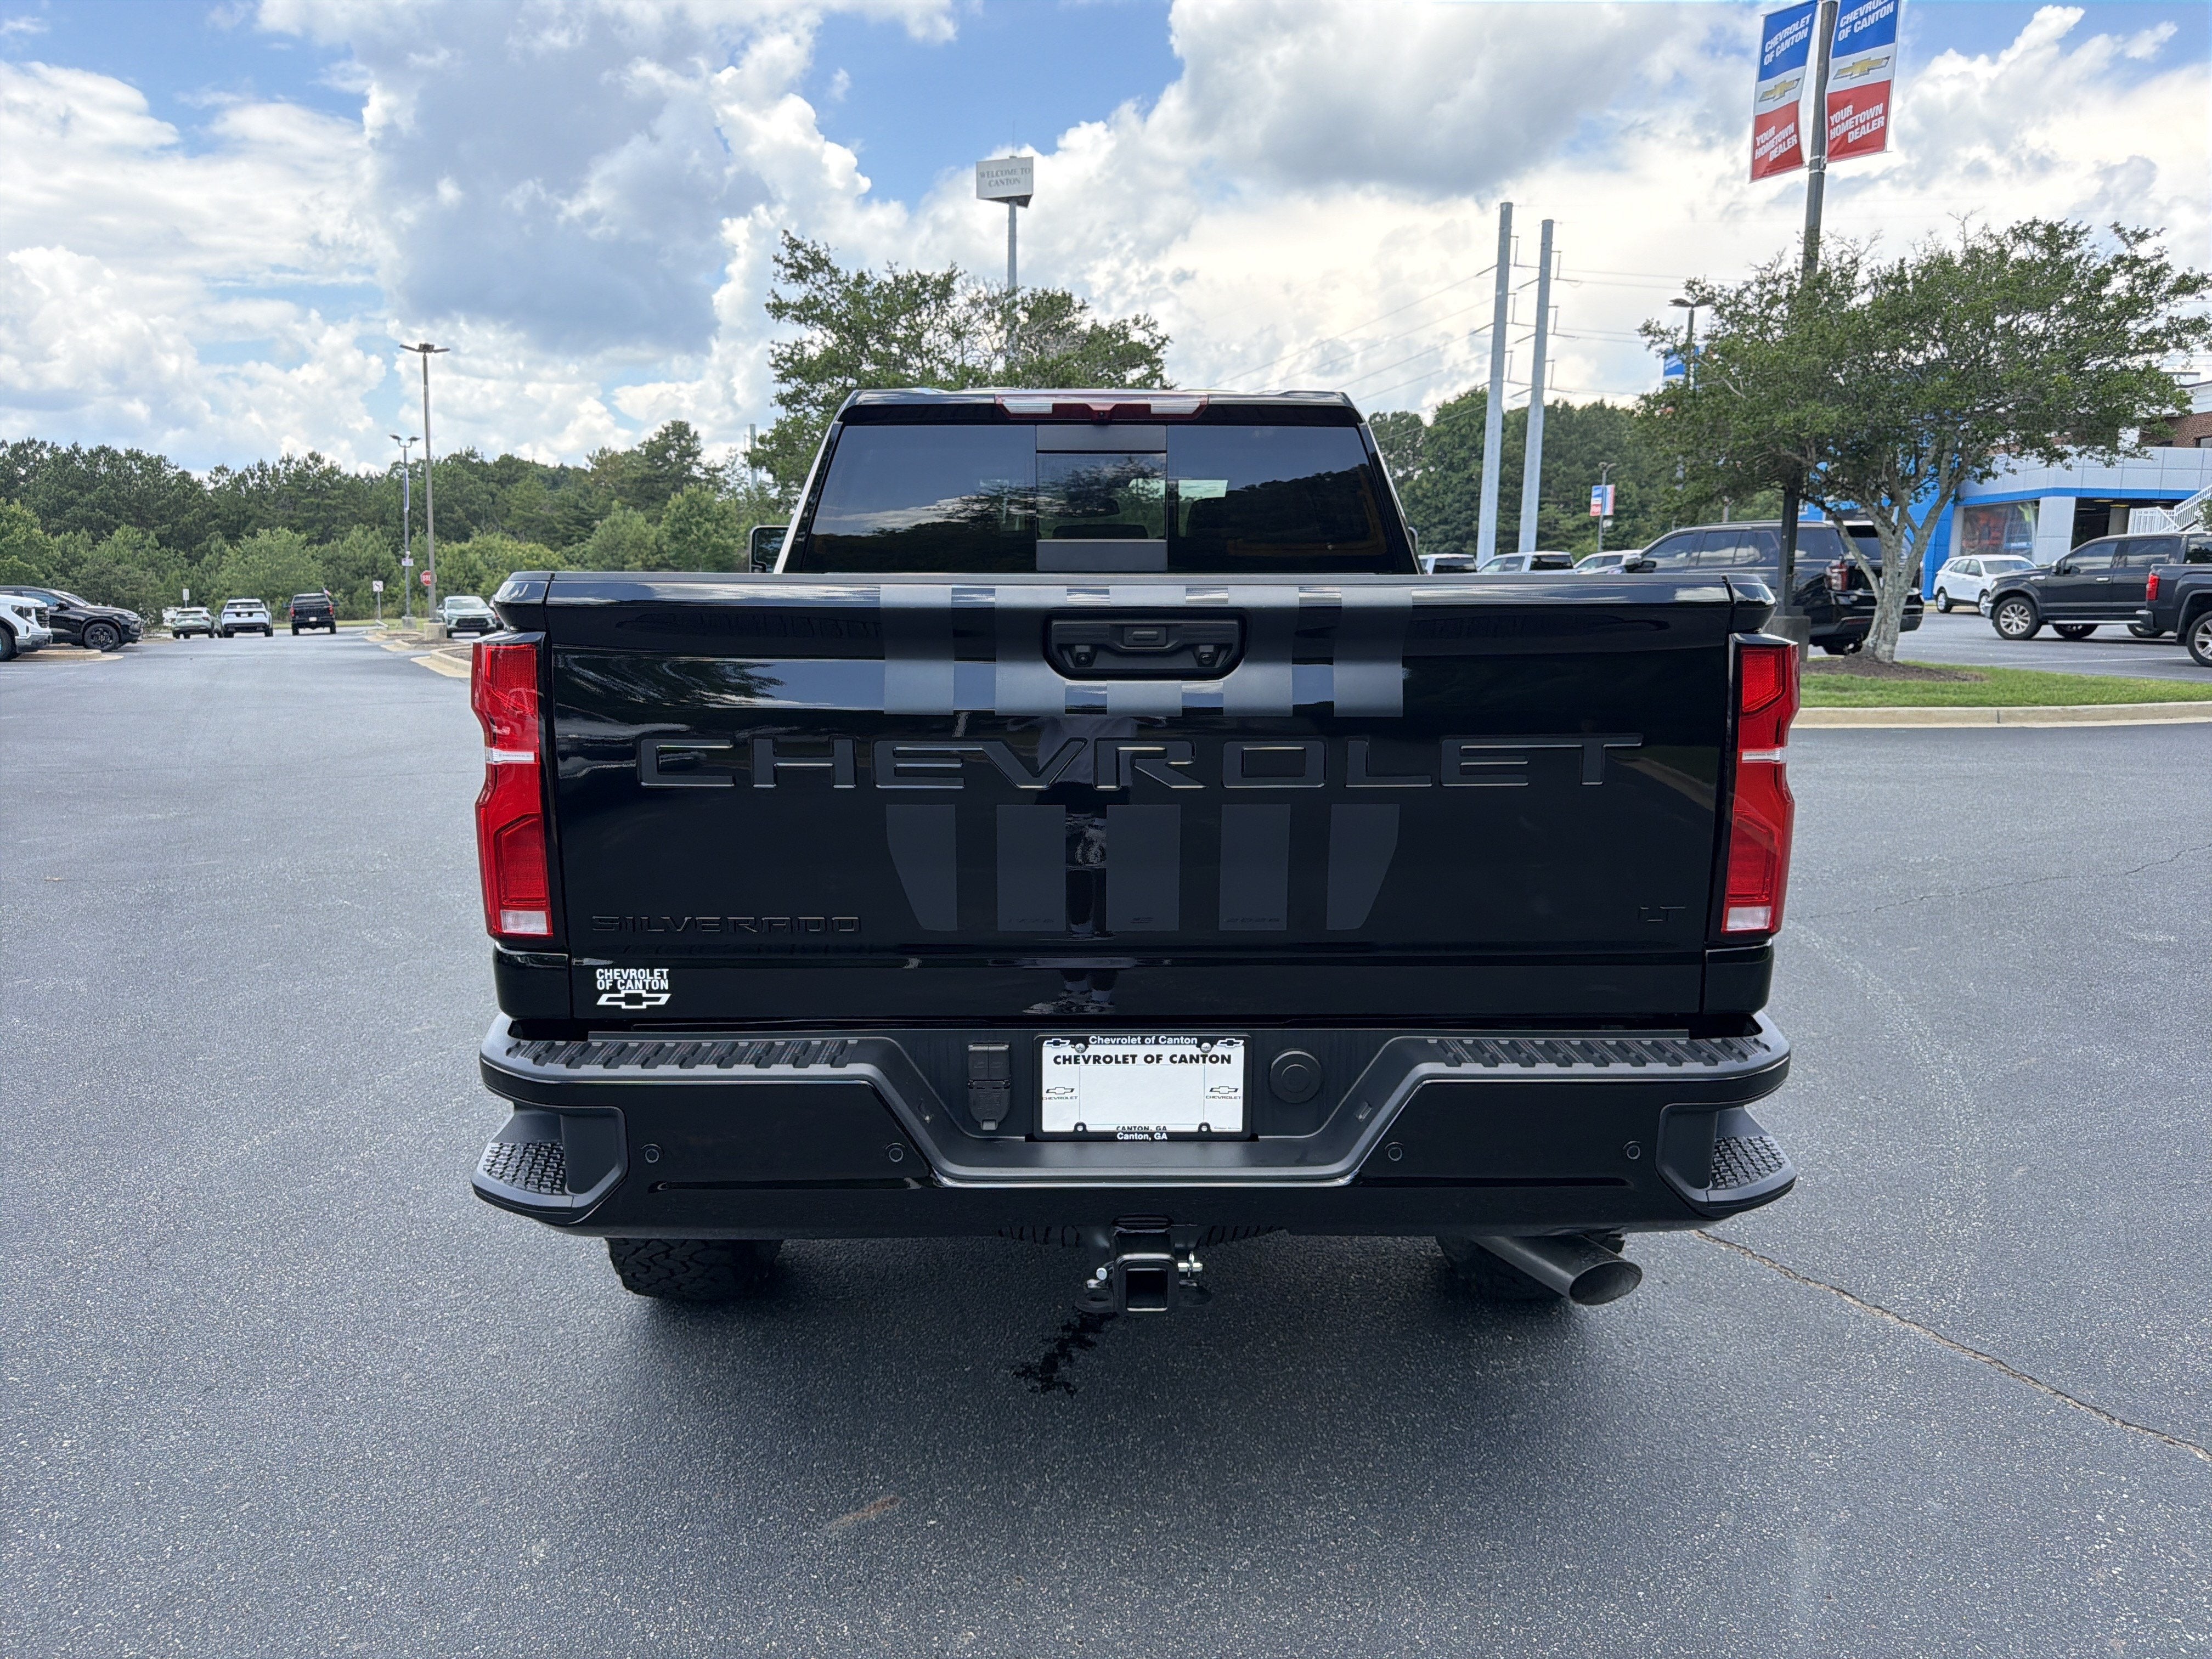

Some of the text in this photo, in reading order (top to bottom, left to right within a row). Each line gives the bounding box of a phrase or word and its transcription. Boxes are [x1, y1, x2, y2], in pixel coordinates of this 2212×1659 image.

[1838, 1, 1894, 41] OF CANTON
[1765, 13, 1812, 53] CHEVROLET
[1764, 27, 1808, 65] OF CANTON
[1830, 104, 1853, 126] YOUR
[1830, 103, 1883, 140] HOMETOWN
[1756, 126, 1776, 146] YOUR
[1848, 116, 1885, 143] DEALER
[1755, 122, 1795, 160] HOMETOWN
[1769, 134, 1798, 162] DEALER
[980, 169, 1017, 178] WELCOME
[989, 178, 1020, 187] CANTON
[637, 733, 1642, 789] CHEVROLET
[591, 916, 861, 932] SILVERADO
[1638, 907, 1686, 922] LT
[596, 968, 669, 980] CHEVROLET
[596, 979, 669, 990] OF CANTON
[1088, 1035, 1198, 1045] Chevrolet of Canton
[1053, 1054, 1232, 1065] CHEVROLET OF CANTON
[1116, 1132, 1168, 1141] Canton, GA
